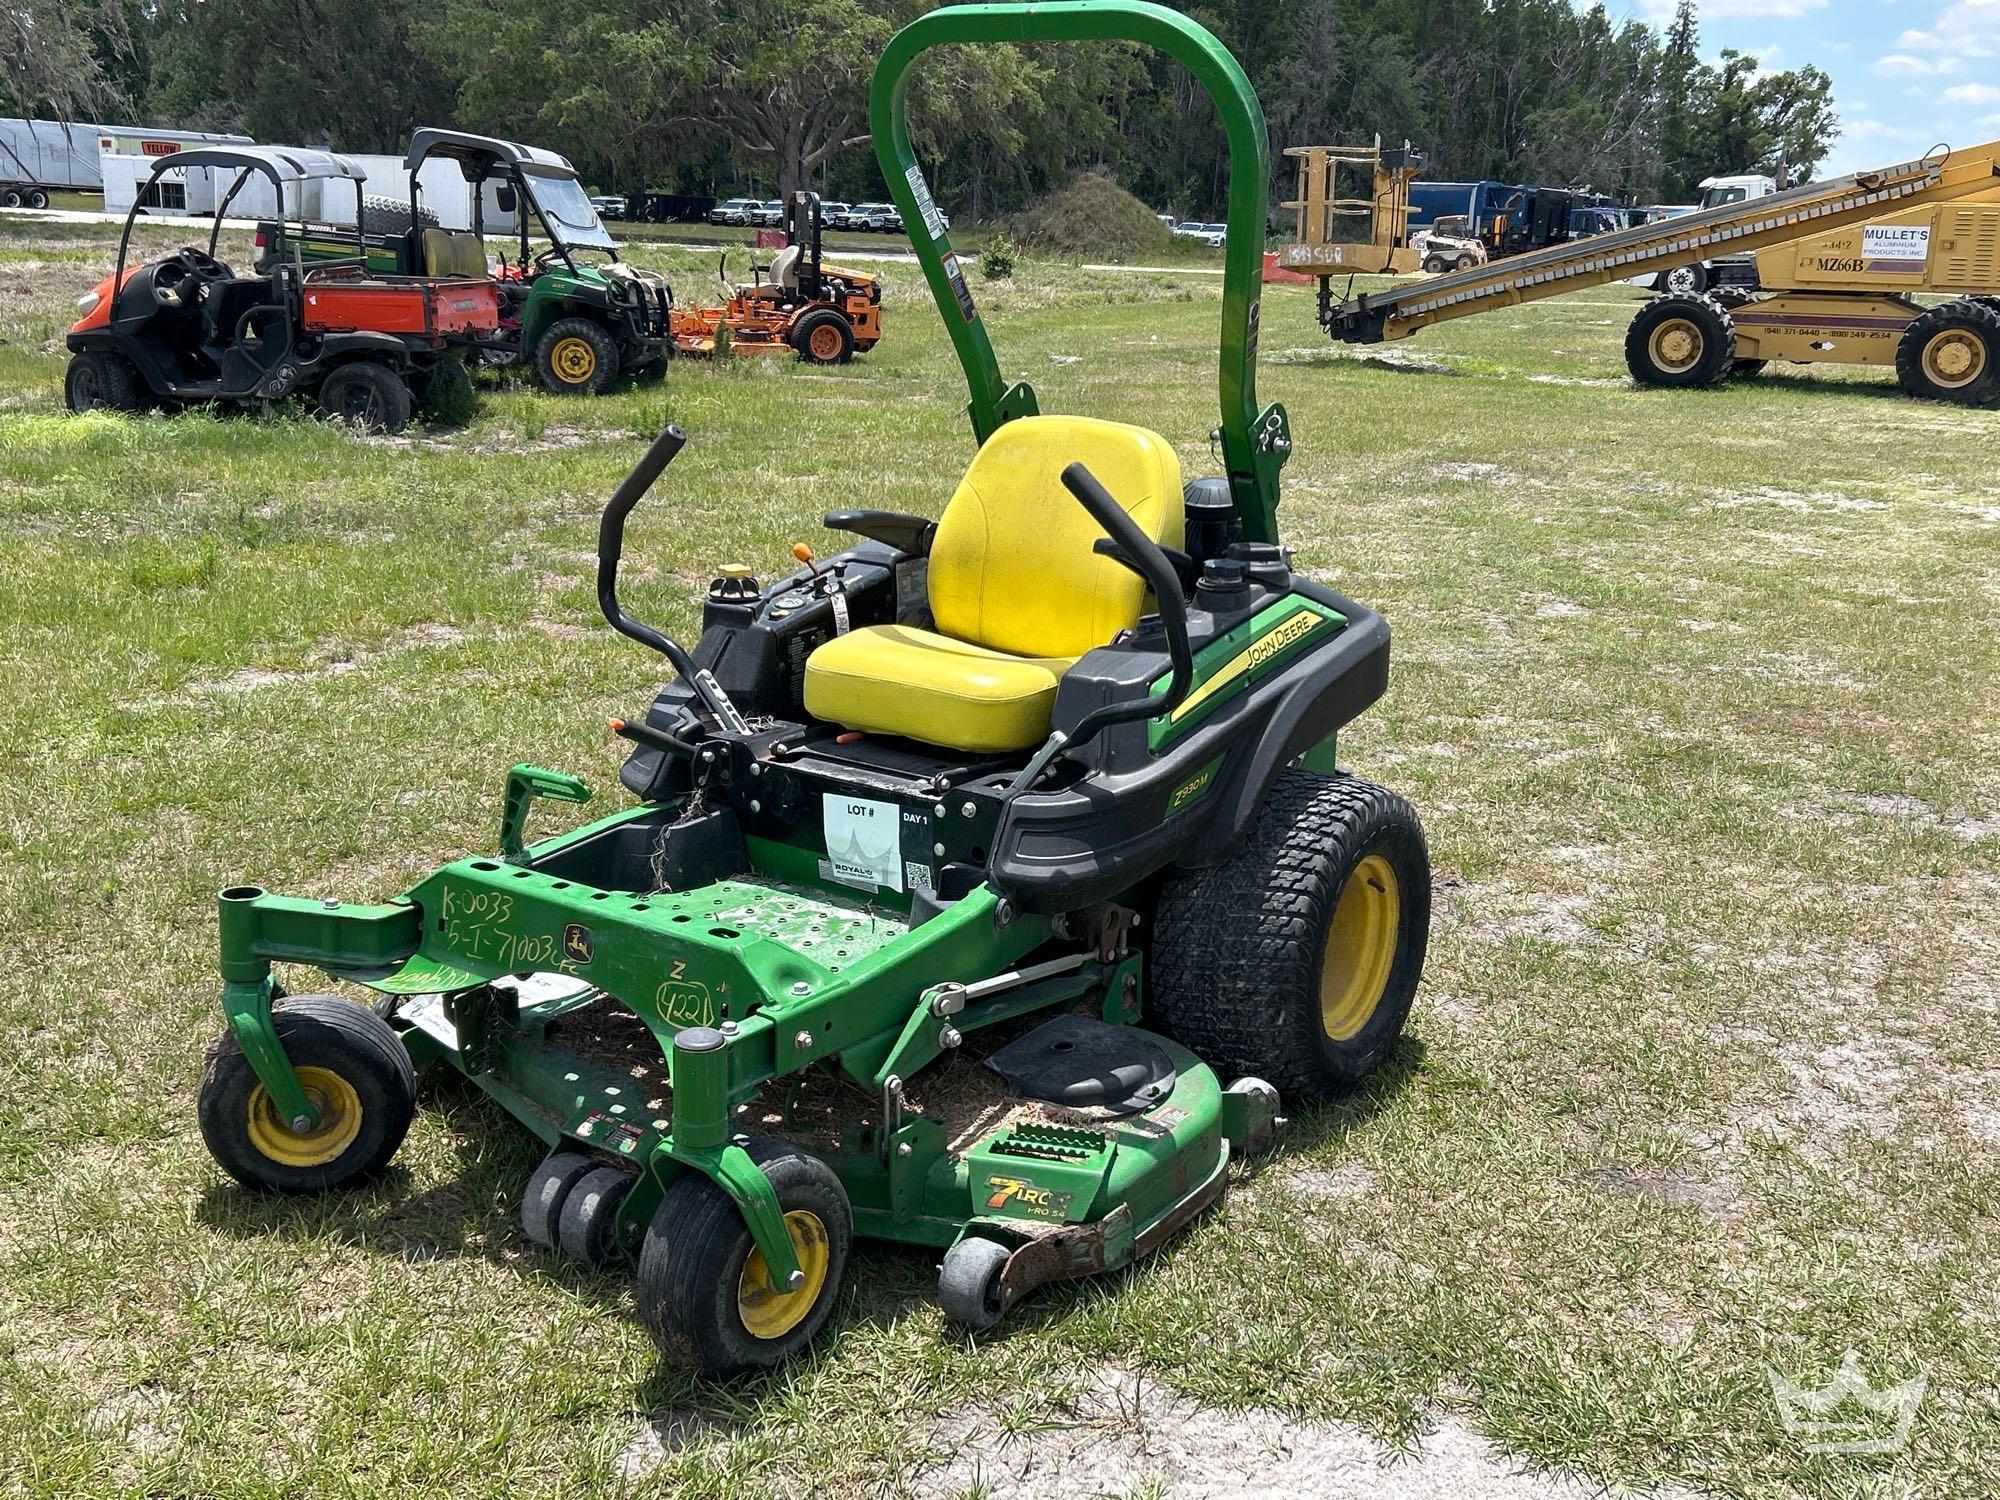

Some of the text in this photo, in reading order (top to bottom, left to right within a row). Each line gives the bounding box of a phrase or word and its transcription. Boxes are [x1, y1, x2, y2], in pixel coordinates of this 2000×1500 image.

[147, 144, 176, 154] YELLOW
[1864, 229, 1929, 240] MULLET'S
[1816, 258, 1864, 272] MZ66B
[1247, 615, 1310, 667] JOHN DEERE
[1173, 773, 1208, 807] Z930M
[847, 804, 875, 817] LOT #
[903, 812, 928, 825] DAY 1
[835, 864, 866, 875] ROYAL
[443, 886, 514, 924] K-0033
[660, 985, 709, 1026] 4221
